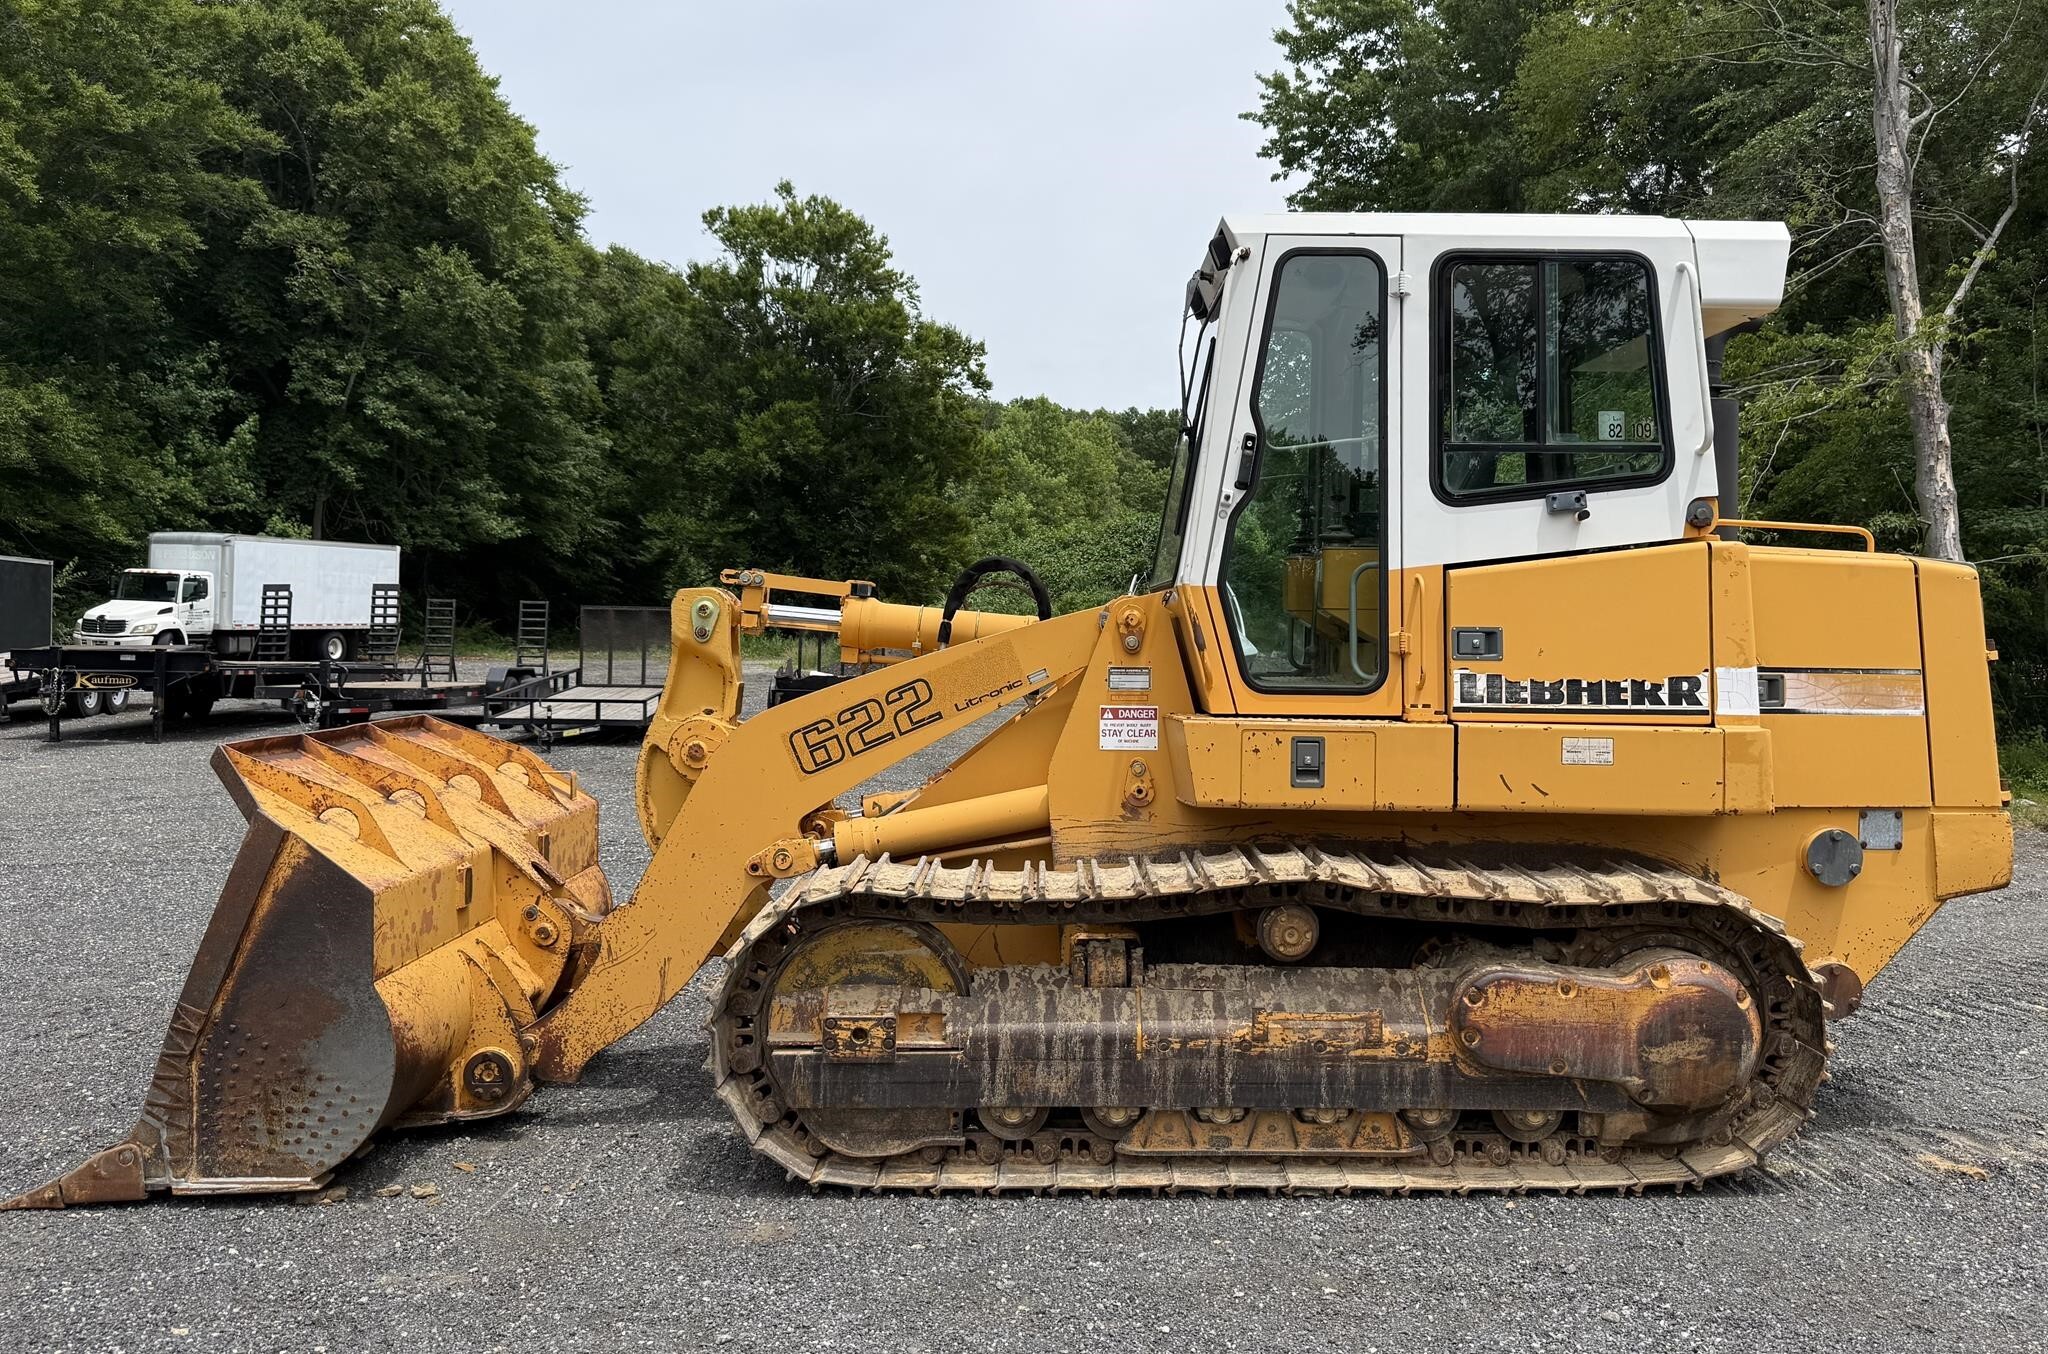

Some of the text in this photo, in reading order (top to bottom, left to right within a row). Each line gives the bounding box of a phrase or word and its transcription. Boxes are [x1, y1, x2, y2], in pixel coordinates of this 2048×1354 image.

[1608, 423, 1623, 438] 82
[1632, 423, 1652, 438] 109
[75, 673, 132, 688] Kaufman
[1460, 673, 1703, 706] LIEBHERR
[1118, 709, 1155, 718] DANGER
[789, 677, 1023, 775] 622 Litronic
[1101, 729, 1156, 737] STAY CLEAR
